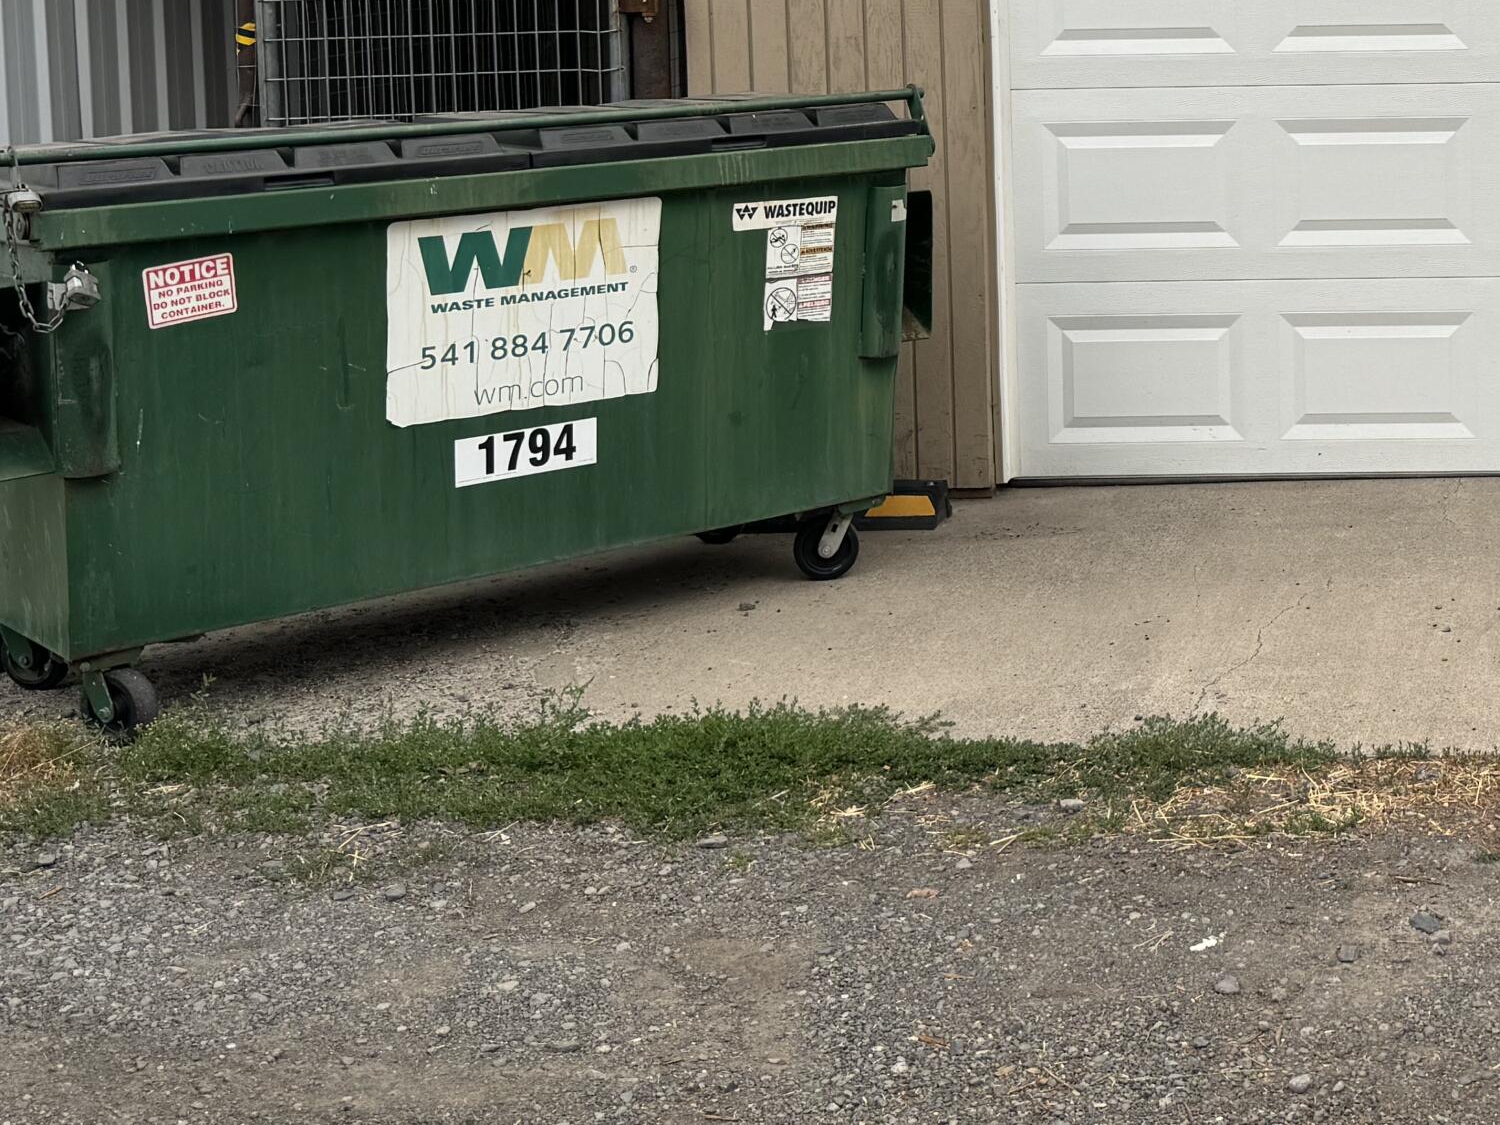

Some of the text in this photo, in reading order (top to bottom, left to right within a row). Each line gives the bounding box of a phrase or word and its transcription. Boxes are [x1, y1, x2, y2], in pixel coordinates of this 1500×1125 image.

[764, 201, 836, 219] WASTEQUIP
[417, 218, 627, 296] WM
[148, 257, 229, 289] NOTICE
[153, 289, 231, 311] DO NOT BLOCK
[158, 279, 223, 299] NO PARKING
[431, 282, 628, 313] WASTE MANAGEMENT
[161, 301, 225, 320] CONTAINER.
[420, 321, 635, 369] 541 884 7706
[474, 375, 583, 405] wm.com
[478, 423, 576, 476] 1794
